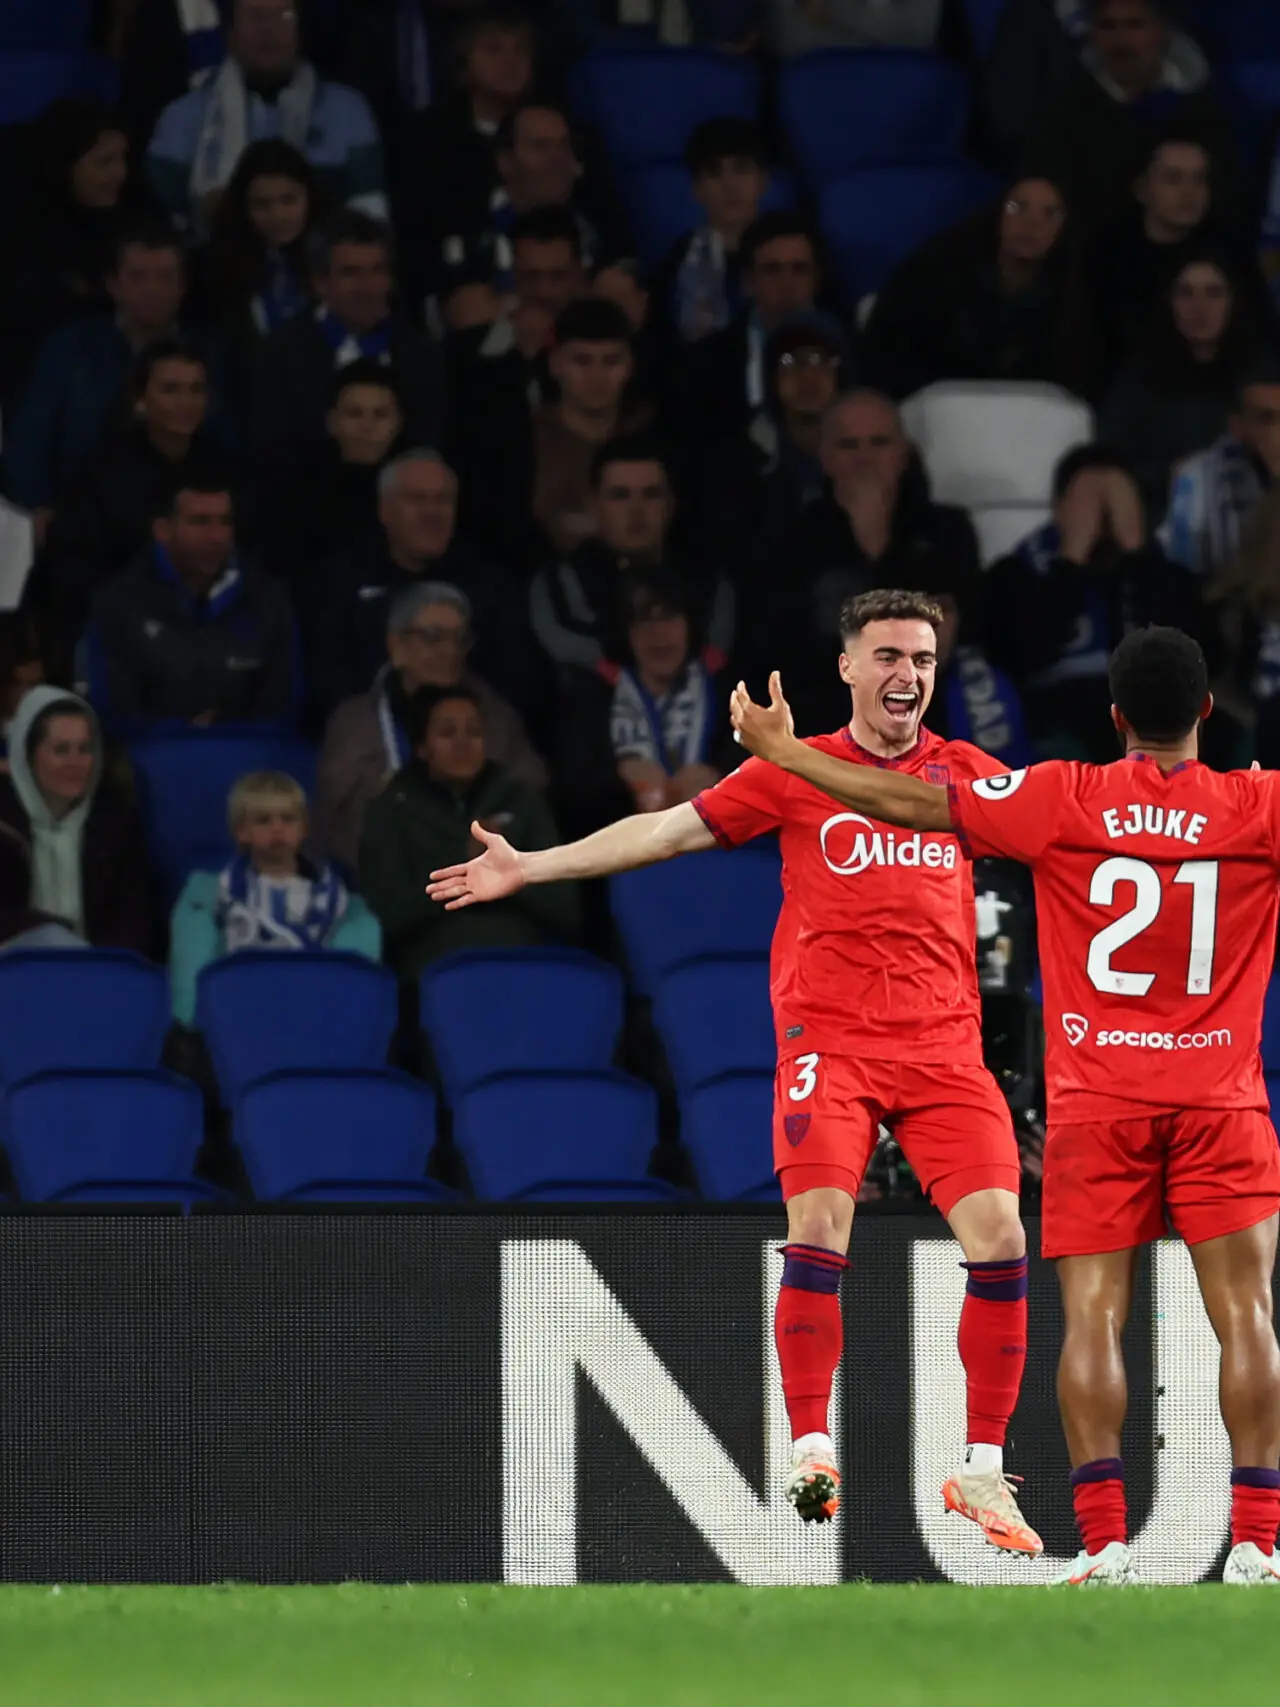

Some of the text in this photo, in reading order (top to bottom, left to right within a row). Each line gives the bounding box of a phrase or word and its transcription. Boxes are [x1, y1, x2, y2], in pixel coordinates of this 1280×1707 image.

[826, 822, 957, 873] Midea
[1102, 803, 1208, 845] EJUKE
[1086, 856, 1219, 996] 21
[788, 1052, 819, 1102] 3
